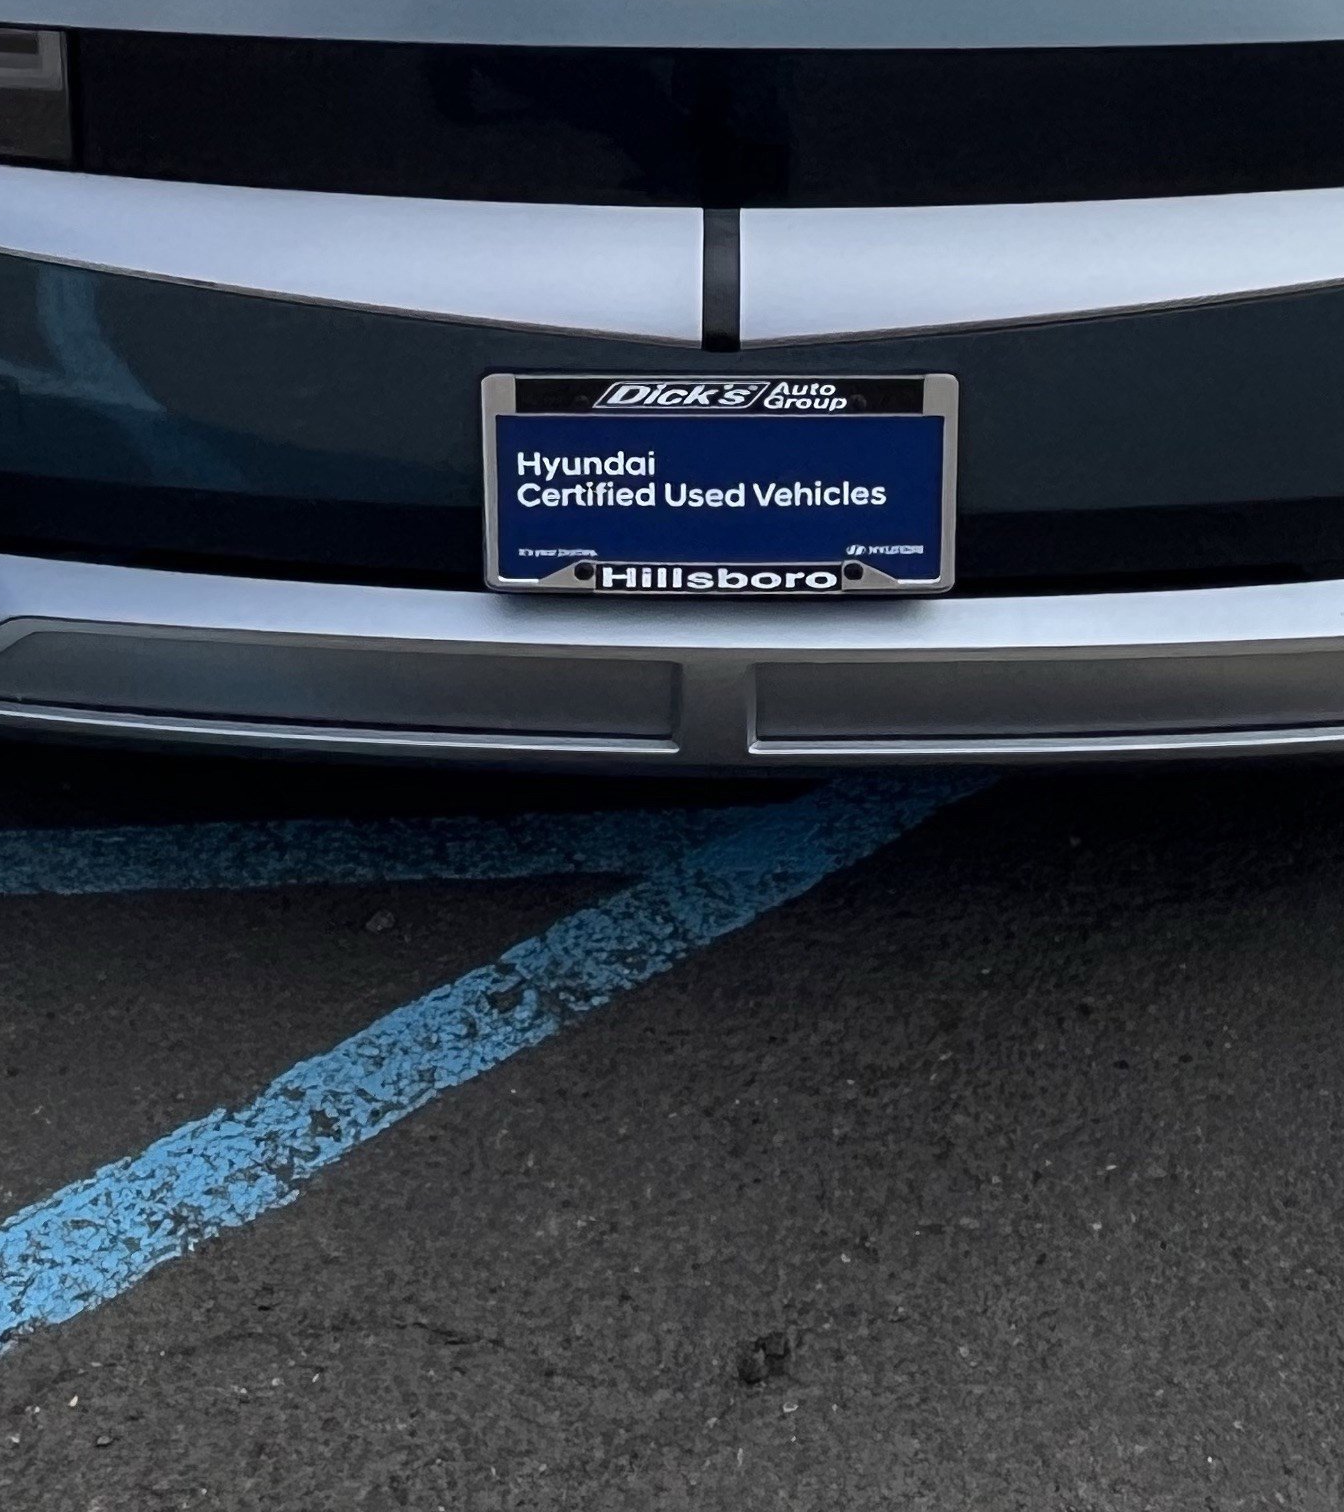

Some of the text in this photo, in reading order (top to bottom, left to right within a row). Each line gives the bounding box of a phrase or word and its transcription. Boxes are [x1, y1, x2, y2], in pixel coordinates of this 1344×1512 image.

[770, 381, 836, 397] Auto
[763, 394, 848, 412] Group
[517, 451, 655, 481] Hyundai
[517, 481, 887, 508] Certified Used Vehicles
[602, 567, 838, 589] Hillsboro
